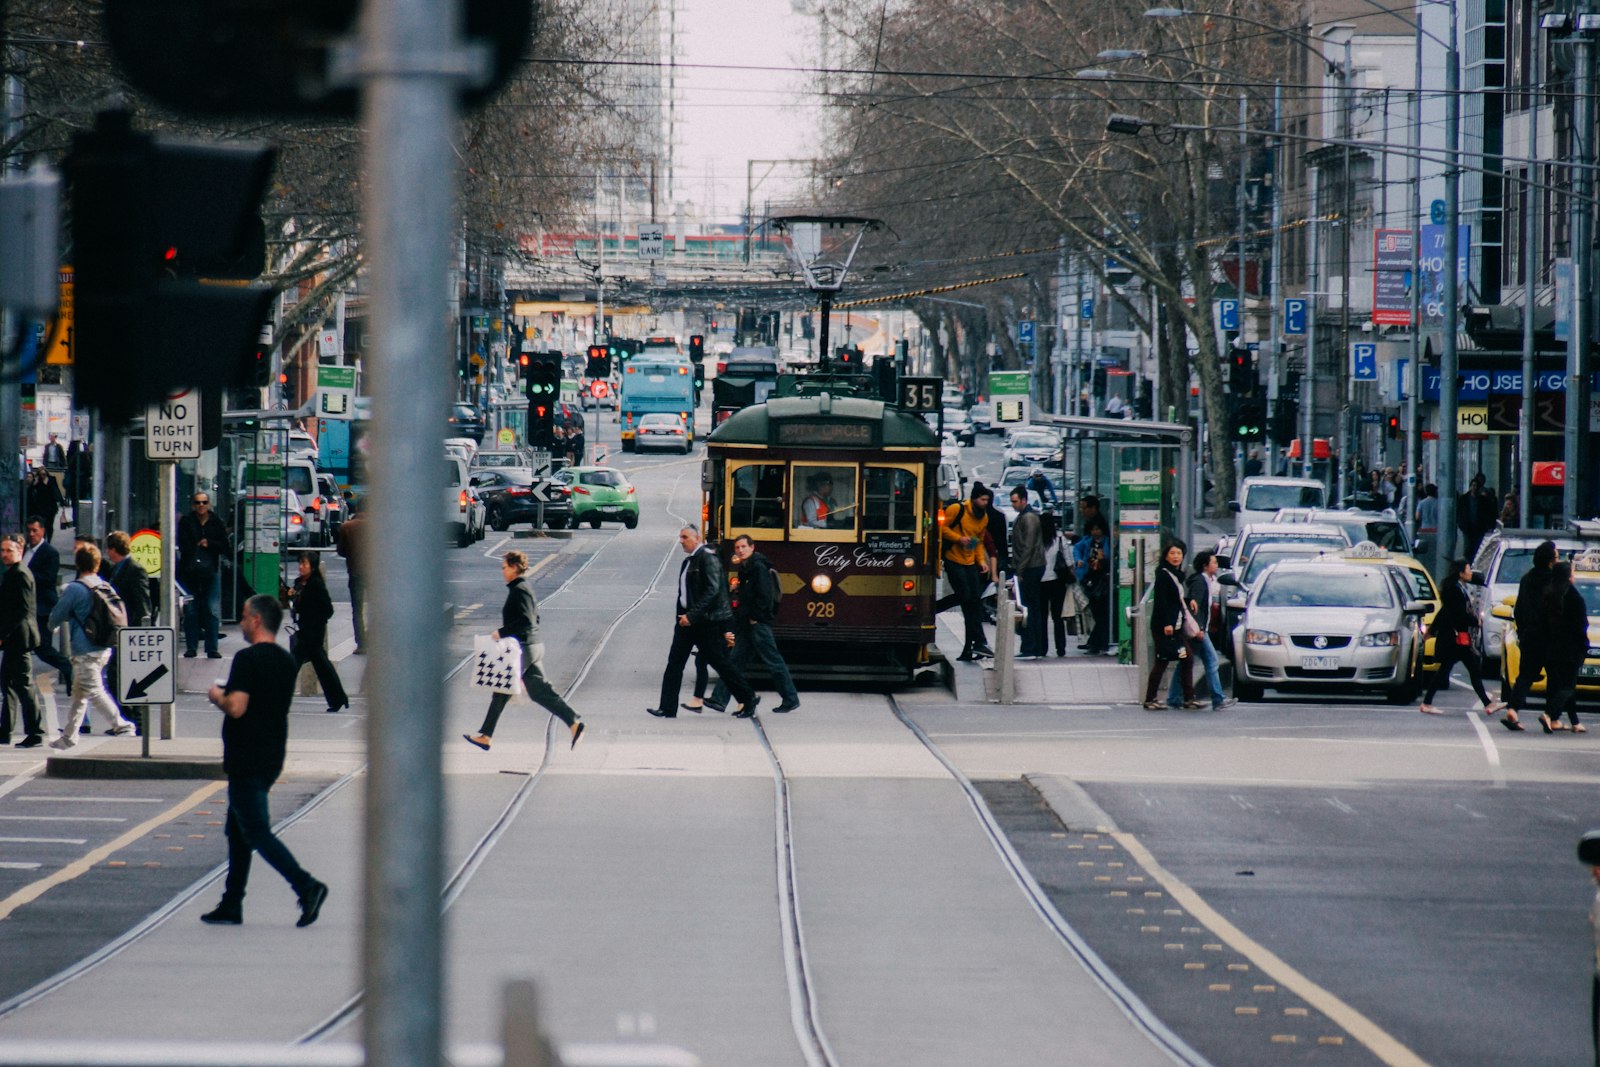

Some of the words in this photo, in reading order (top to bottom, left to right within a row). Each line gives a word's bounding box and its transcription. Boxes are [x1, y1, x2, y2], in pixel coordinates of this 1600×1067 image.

[641, 247, 661, 255] LANE
[1223, 301, 1234, 315] P
[1289, 301, 1302, 317] P
[1022, 323, 1032, 334] P
[1358, 346, 1372, 363] P
[905, 384, 934, 408] 35
[160, 404, 187, 420] NO
[153, 425, 195, 436] RIGHT
[154, 441, 192, 452] TURN
[814, 545, 851, 572] City
[853, 547, 896, 567] Circle
[806, 602, 835, 618] 928
[129, 635, 165, 646] KEEP
[130, 651, 164, 662] LEFT
